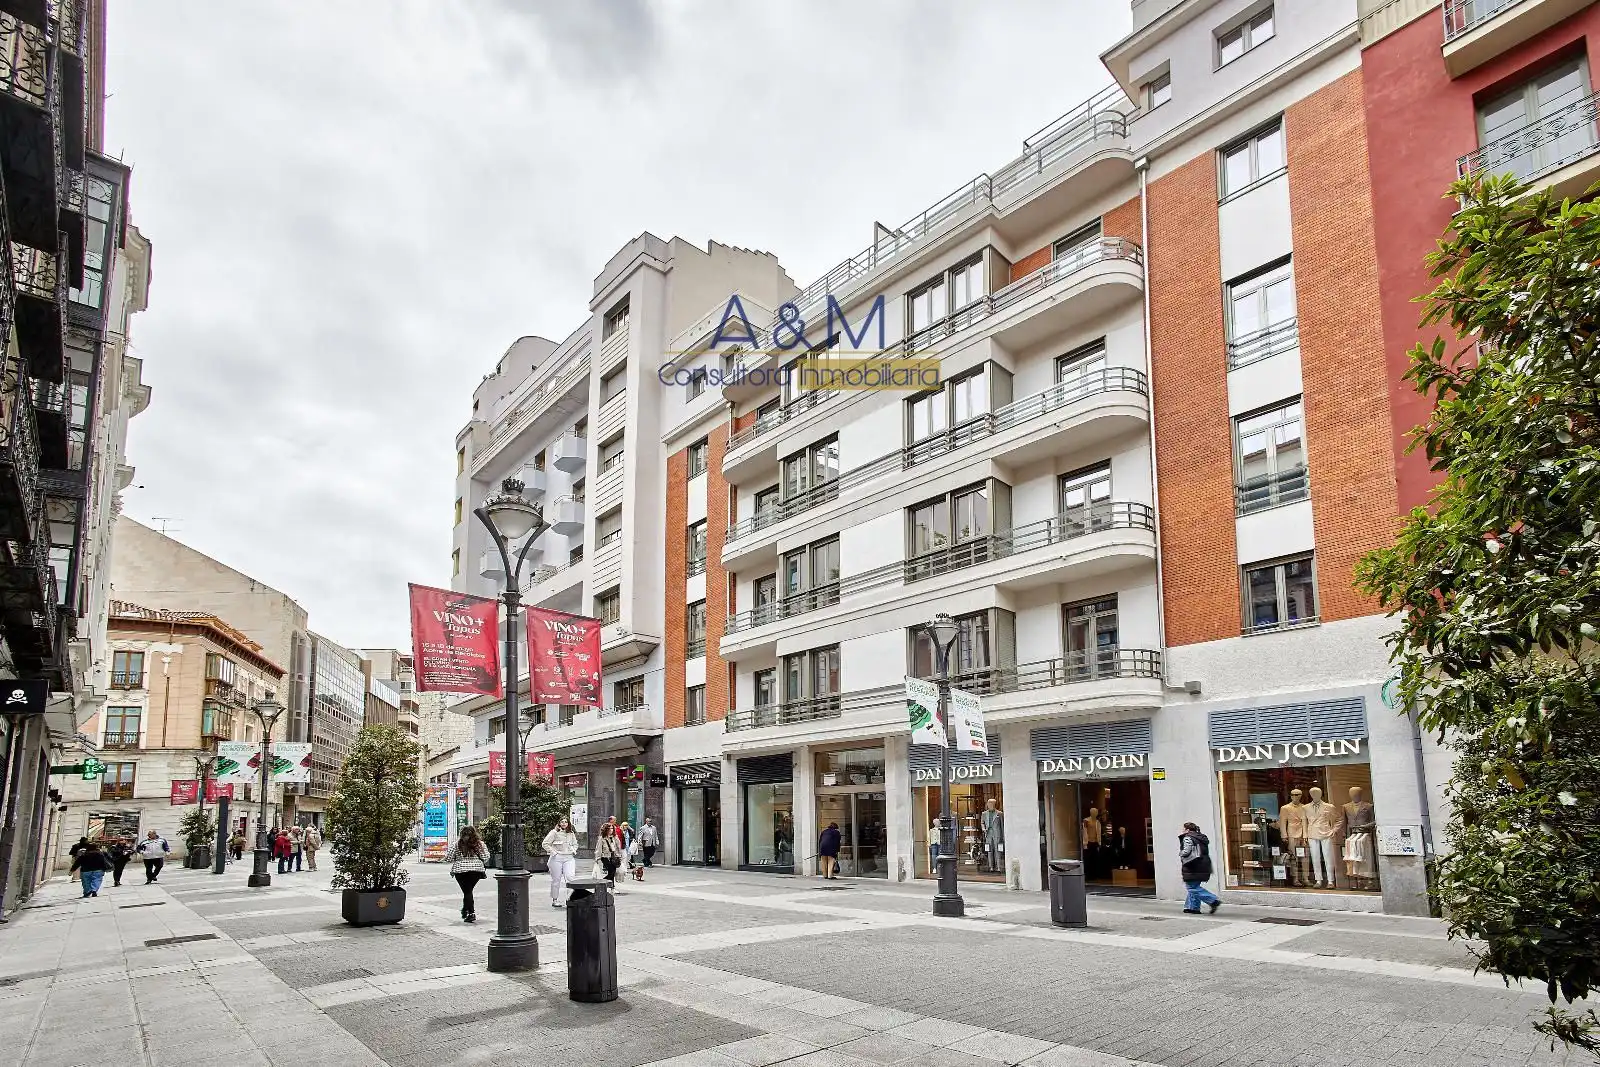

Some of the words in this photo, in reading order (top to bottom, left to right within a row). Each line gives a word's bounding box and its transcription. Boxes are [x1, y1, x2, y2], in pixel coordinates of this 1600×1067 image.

[1217, 744, 1274, 763] DAN
[1278, 738, 1362, 764] JOHN
[948, 764, 994, 783] JOHN
[1041, 757, 1083, 773] DAN
[1086, 753, 1145, 775] JOHN
